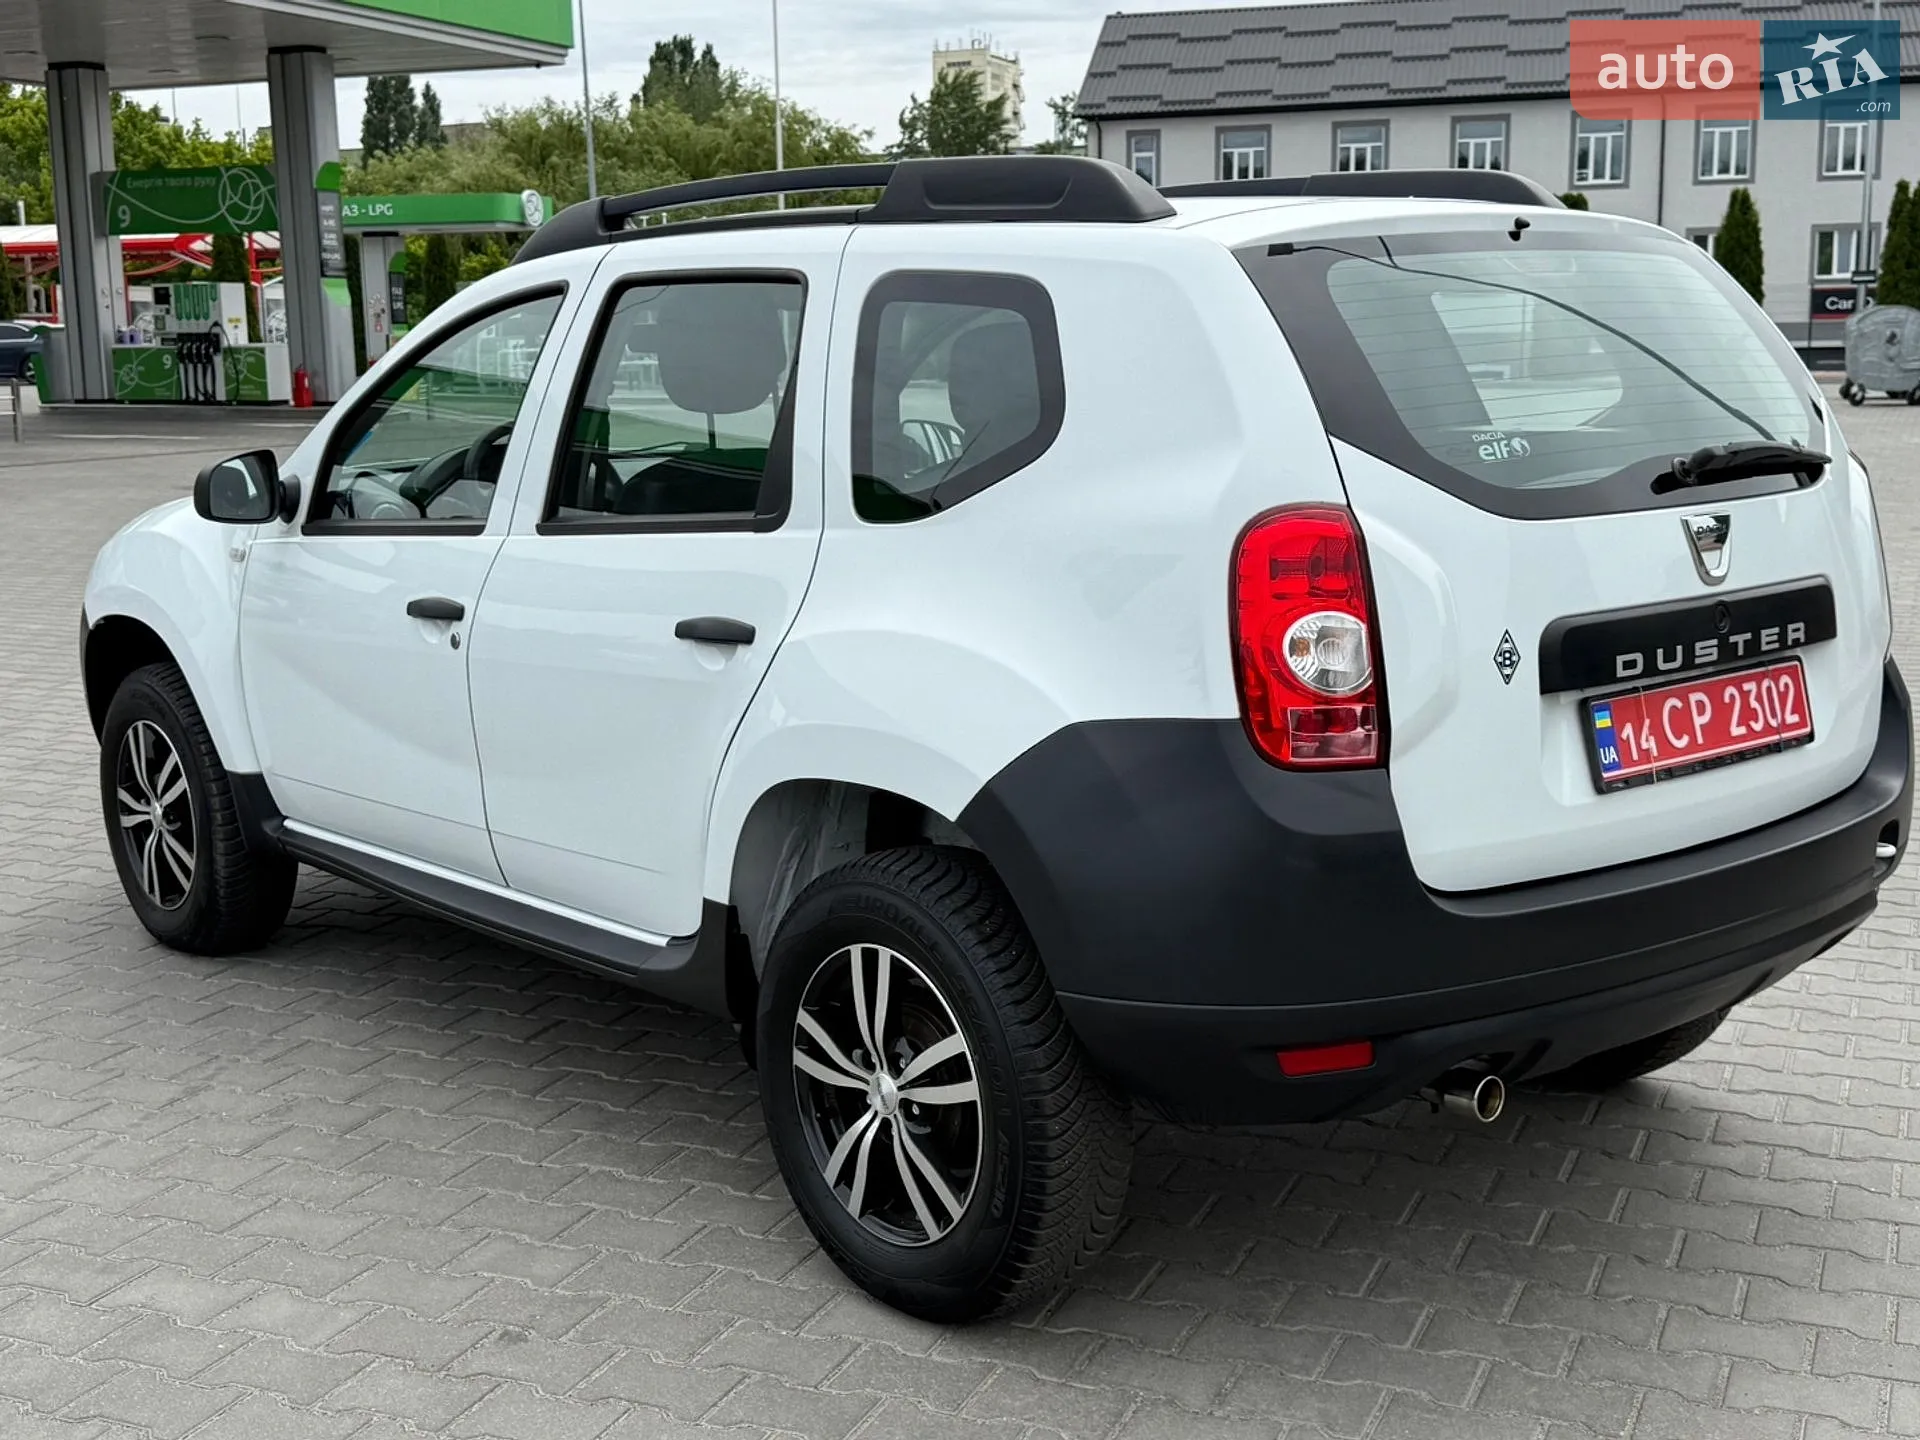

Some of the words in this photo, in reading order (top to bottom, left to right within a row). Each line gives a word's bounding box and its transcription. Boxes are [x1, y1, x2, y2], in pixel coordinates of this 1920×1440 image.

[116, 204, 132, 229] 9
[342, 204, 360, 217] АЗ
[368, 202, 394, 216] LPG
[1824, 295, 1855, 311] Car
[162, 353, 173, 370] 9
[1472, 431, 1506, 443] DACIA
[1478, 439, 1511, 461] elf
[1615, 621, 1807, 678] DUSTER
[1620, 717, 1659, 762] 14
[1662, 691, 1713, 750] CP
[1723, 673, 1801, 738] 2302
[1600, 746, 1619, 765] UA
